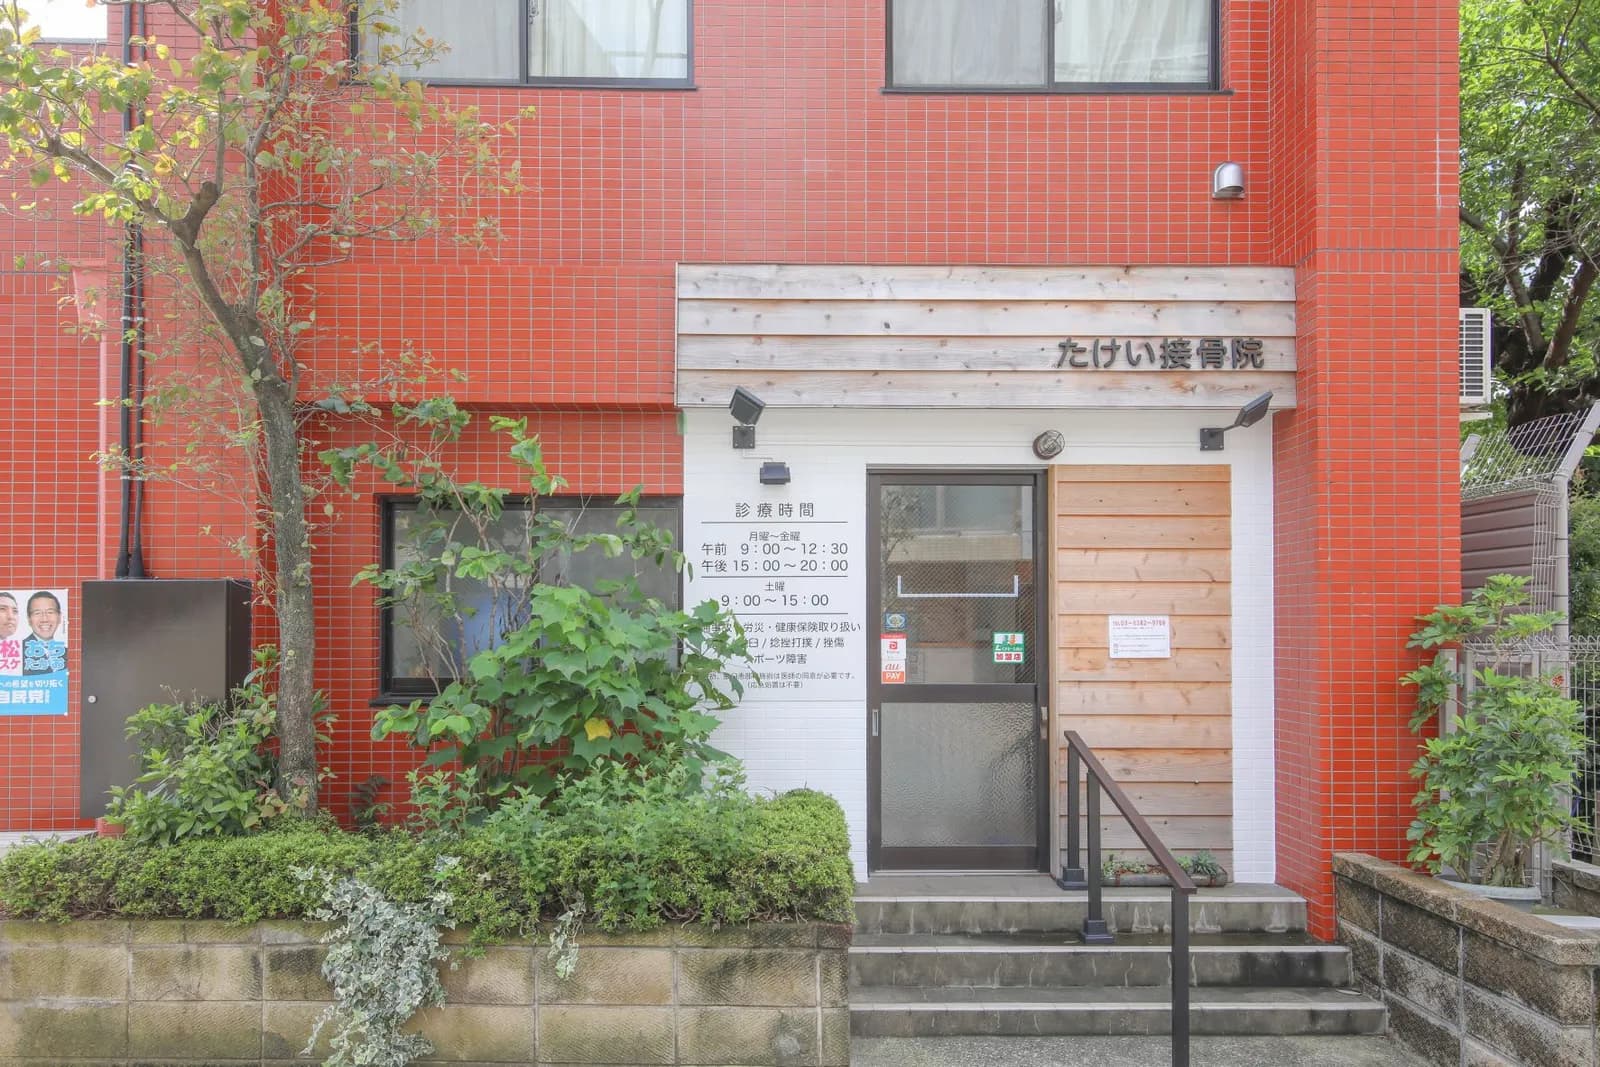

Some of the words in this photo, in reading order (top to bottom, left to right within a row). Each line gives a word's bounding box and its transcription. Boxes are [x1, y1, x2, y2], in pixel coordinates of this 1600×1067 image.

[1057, 336, 1265, 369] たけい接骨院
[735, 502, 814, 518] 診療時間
[701, 543, 727, 556] 午前
[701, 560, 727, 572] 午後
[765, 581, 785, 592] 土曜
[885, 671, 901, 680] PAY
